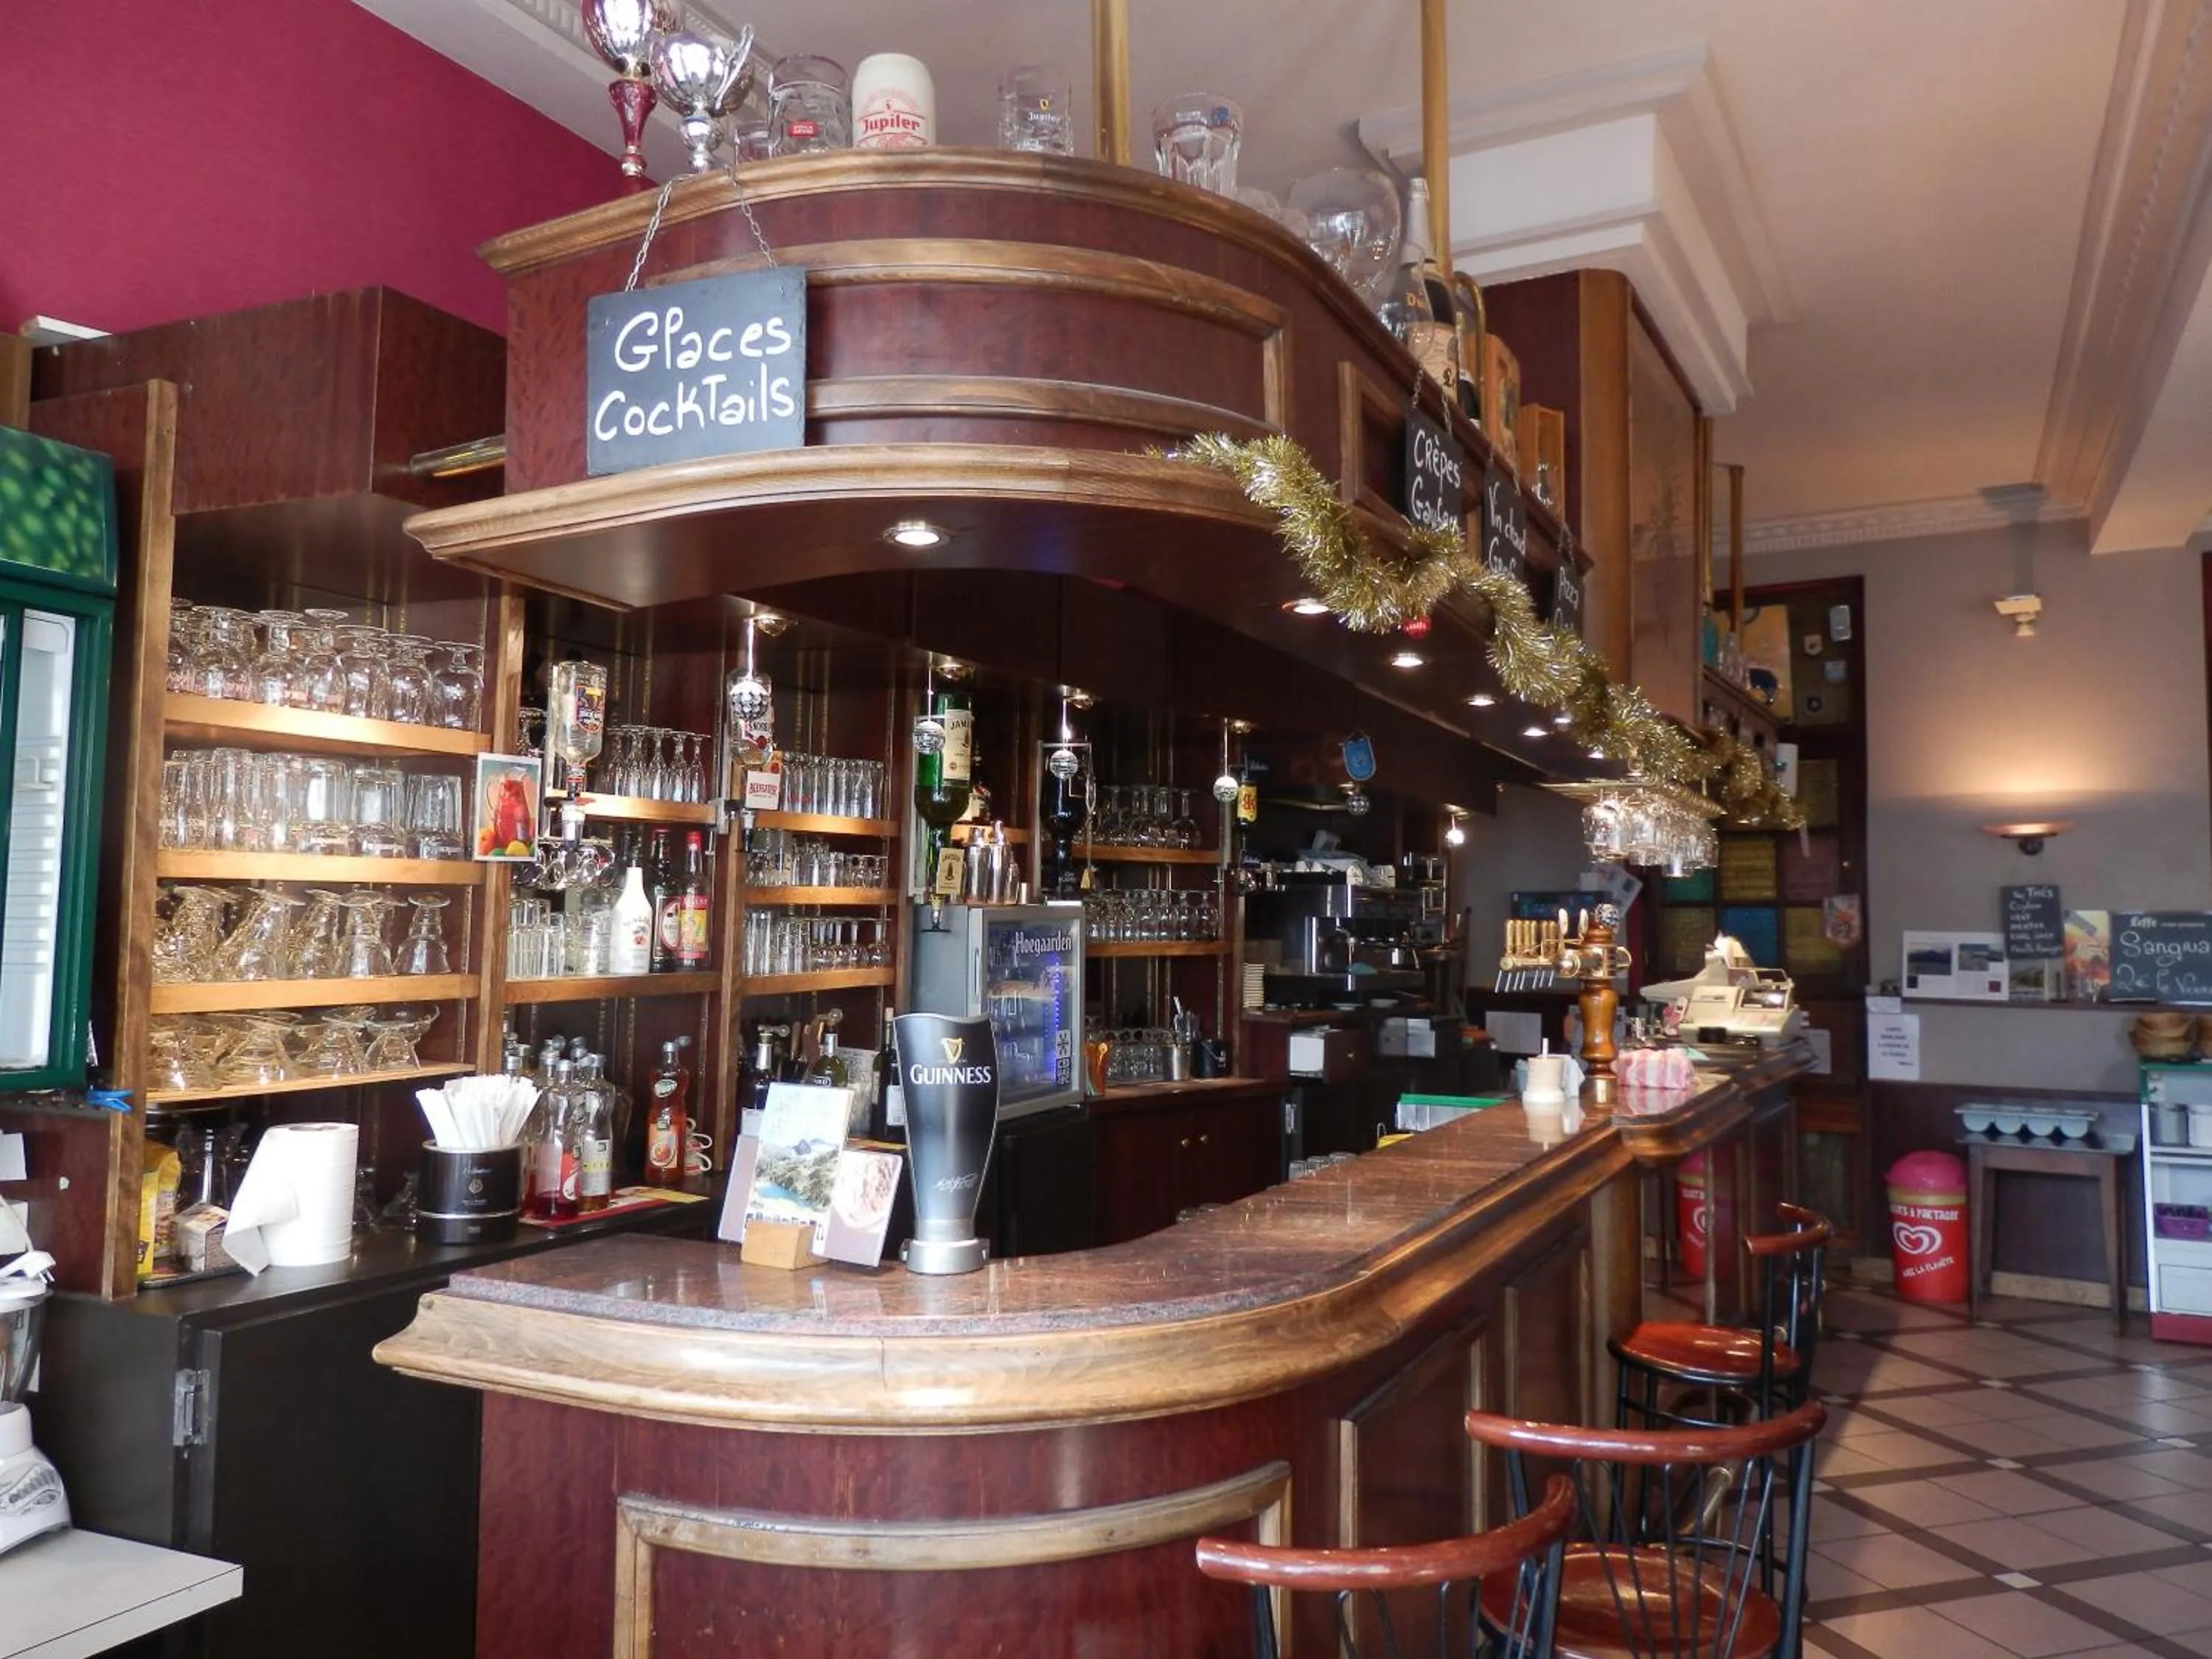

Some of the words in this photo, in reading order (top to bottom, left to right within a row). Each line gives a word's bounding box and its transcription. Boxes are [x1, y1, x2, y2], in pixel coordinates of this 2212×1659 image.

[863, 114, 921, 133] Jupiler
[614, 306, 792, 373] Glaces
[1015, 930, 1072, 956] Hoegaarden
